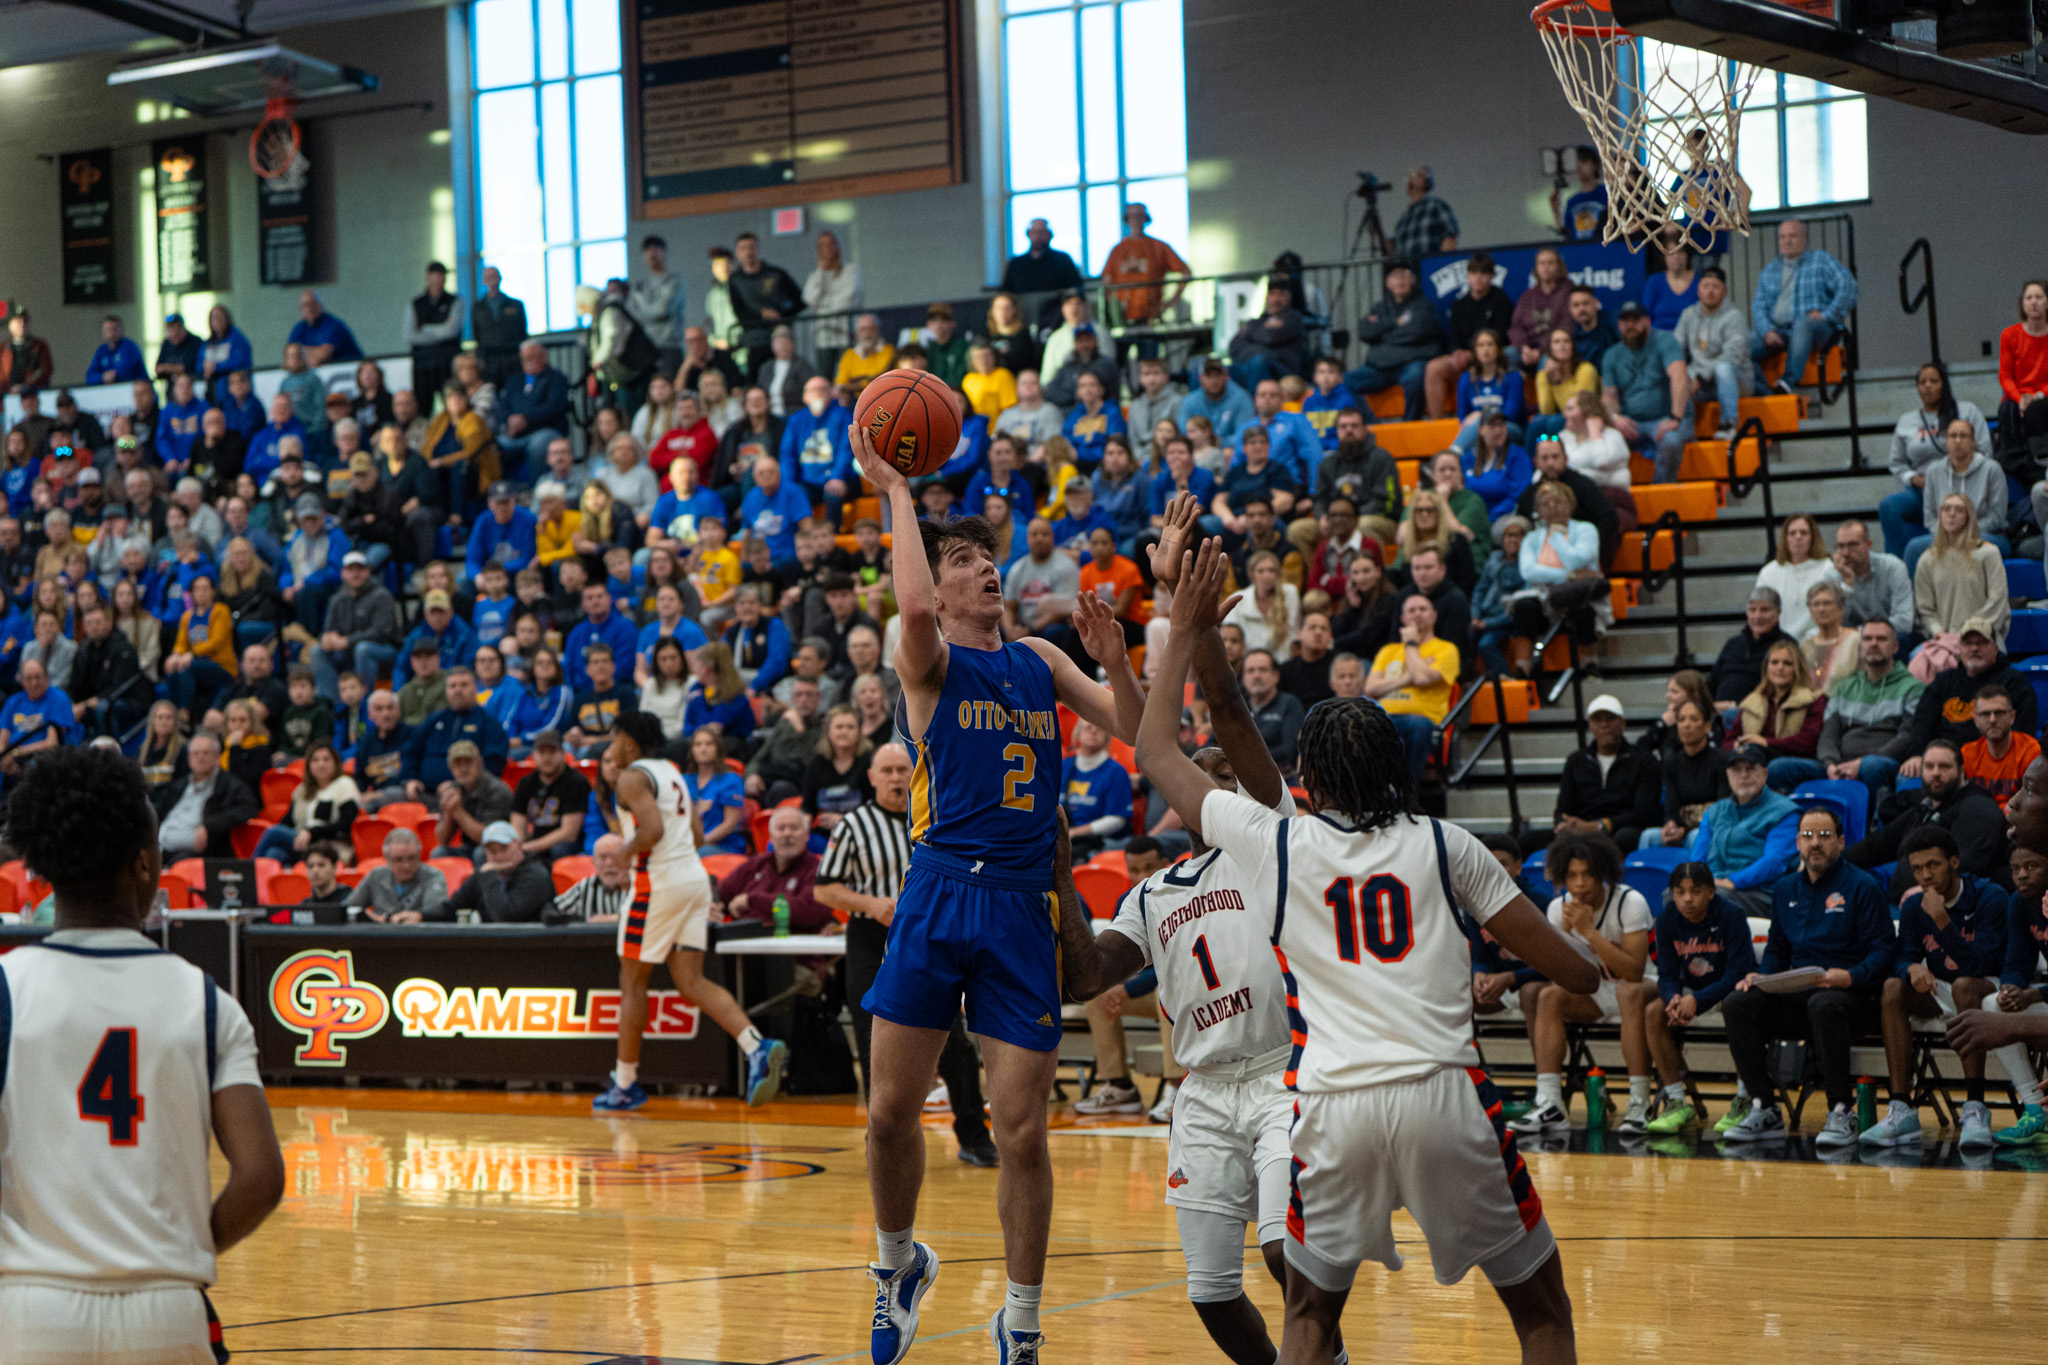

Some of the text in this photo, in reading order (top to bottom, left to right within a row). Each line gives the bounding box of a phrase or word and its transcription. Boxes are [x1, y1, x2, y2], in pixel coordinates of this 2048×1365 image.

[672, 781, 686, 816] 2
[1000, 742, 1036, 812] 2
[1324, 872, 1415, 964] 10
[1191, 933, 1222, 992] 1
[1191, 986, 1254, 1032] ACADEMY
[77, 1026, 145, 1147] 4
